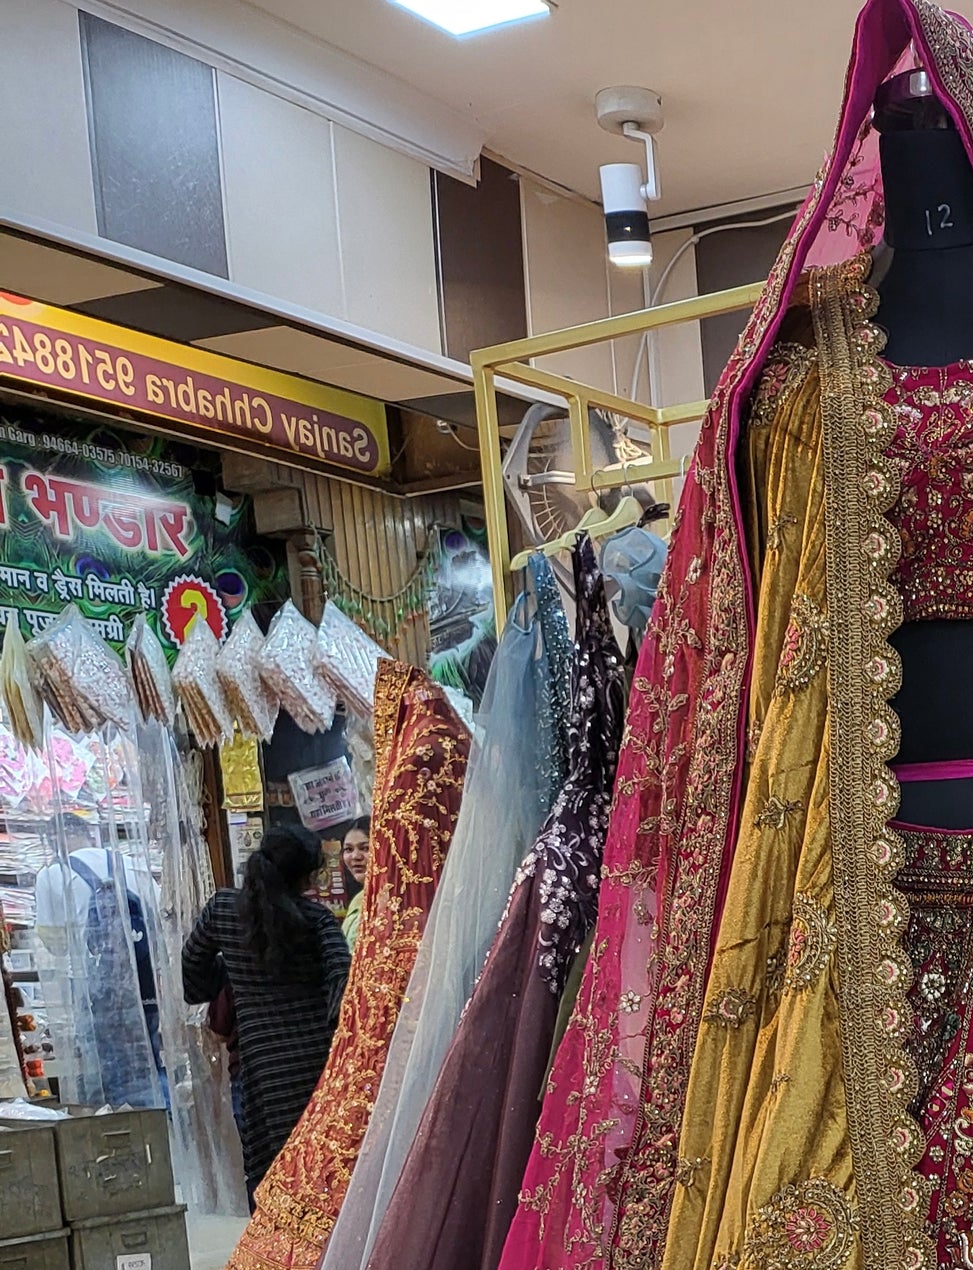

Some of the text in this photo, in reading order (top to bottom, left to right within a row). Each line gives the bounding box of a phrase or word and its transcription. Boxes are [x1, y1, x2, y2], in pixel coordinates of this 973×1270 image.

[926, 203, 954, 236] 12
[8, 426, 36, 447] Garg
[24, 473, 189, 557] भण्डार
[86, 574, 135, 605] मिलती
